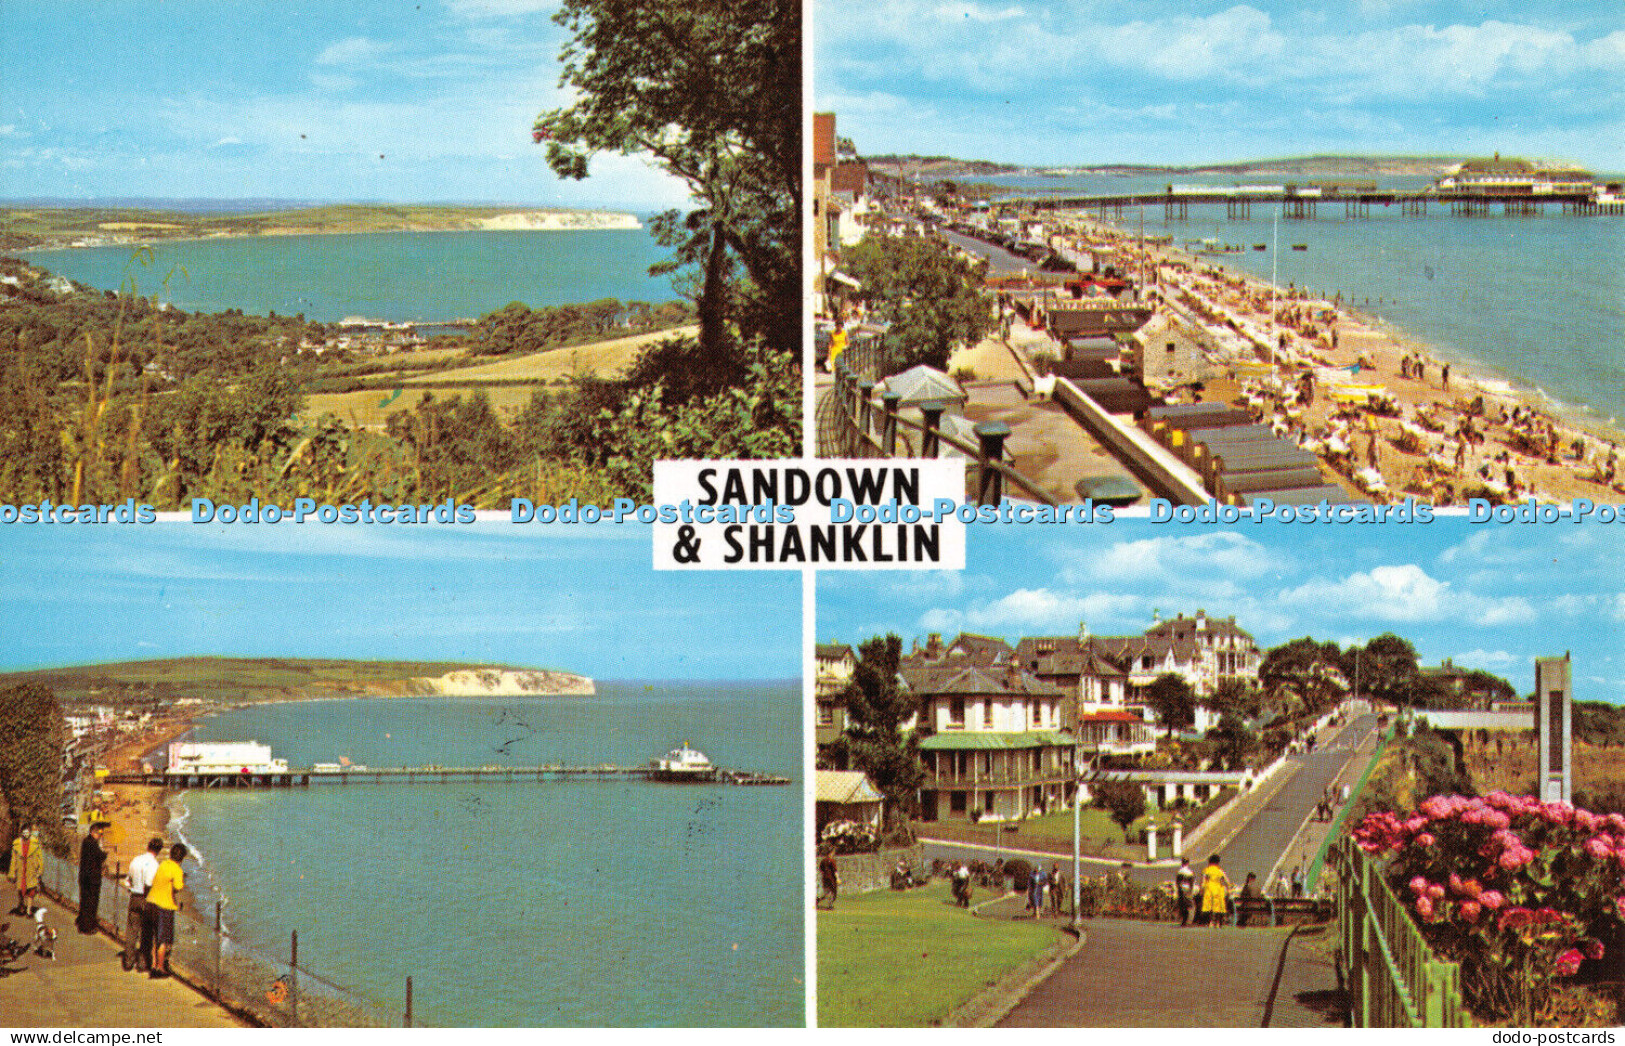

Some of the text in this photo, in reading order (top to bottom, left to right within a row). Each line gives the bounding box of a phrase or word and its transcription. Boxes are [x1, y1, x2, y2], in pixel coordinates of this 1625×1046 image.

[697, 467, 919, 506] SANDOWN
[672, 524, 940, 563] & SHANKLIN
